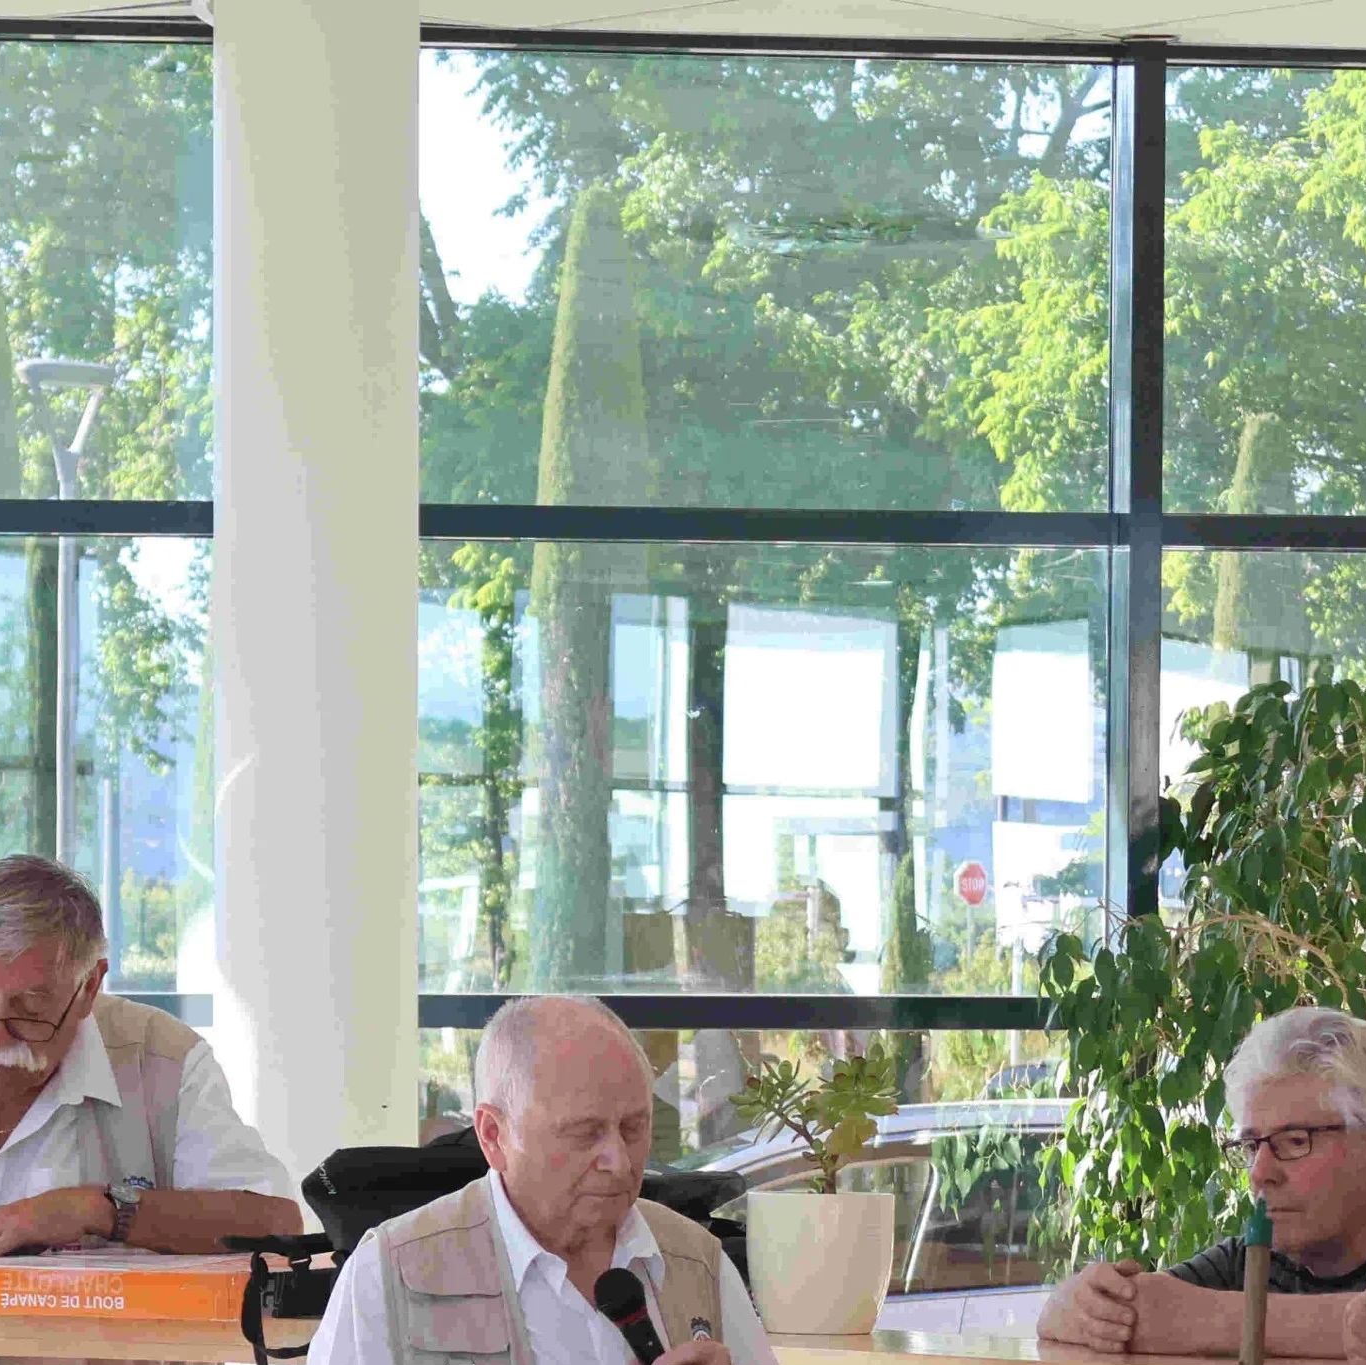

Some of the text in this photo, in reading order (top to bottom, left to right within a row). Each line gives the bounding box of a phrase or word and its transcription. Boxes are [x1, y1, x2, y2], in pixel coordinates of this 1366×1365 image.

[960, 877, 984, 892] STOP
[0, 1271, 124, 1294] CHARLOTTE
[0, 1292, 124, 1309] BOUT DE CANAPÉ
